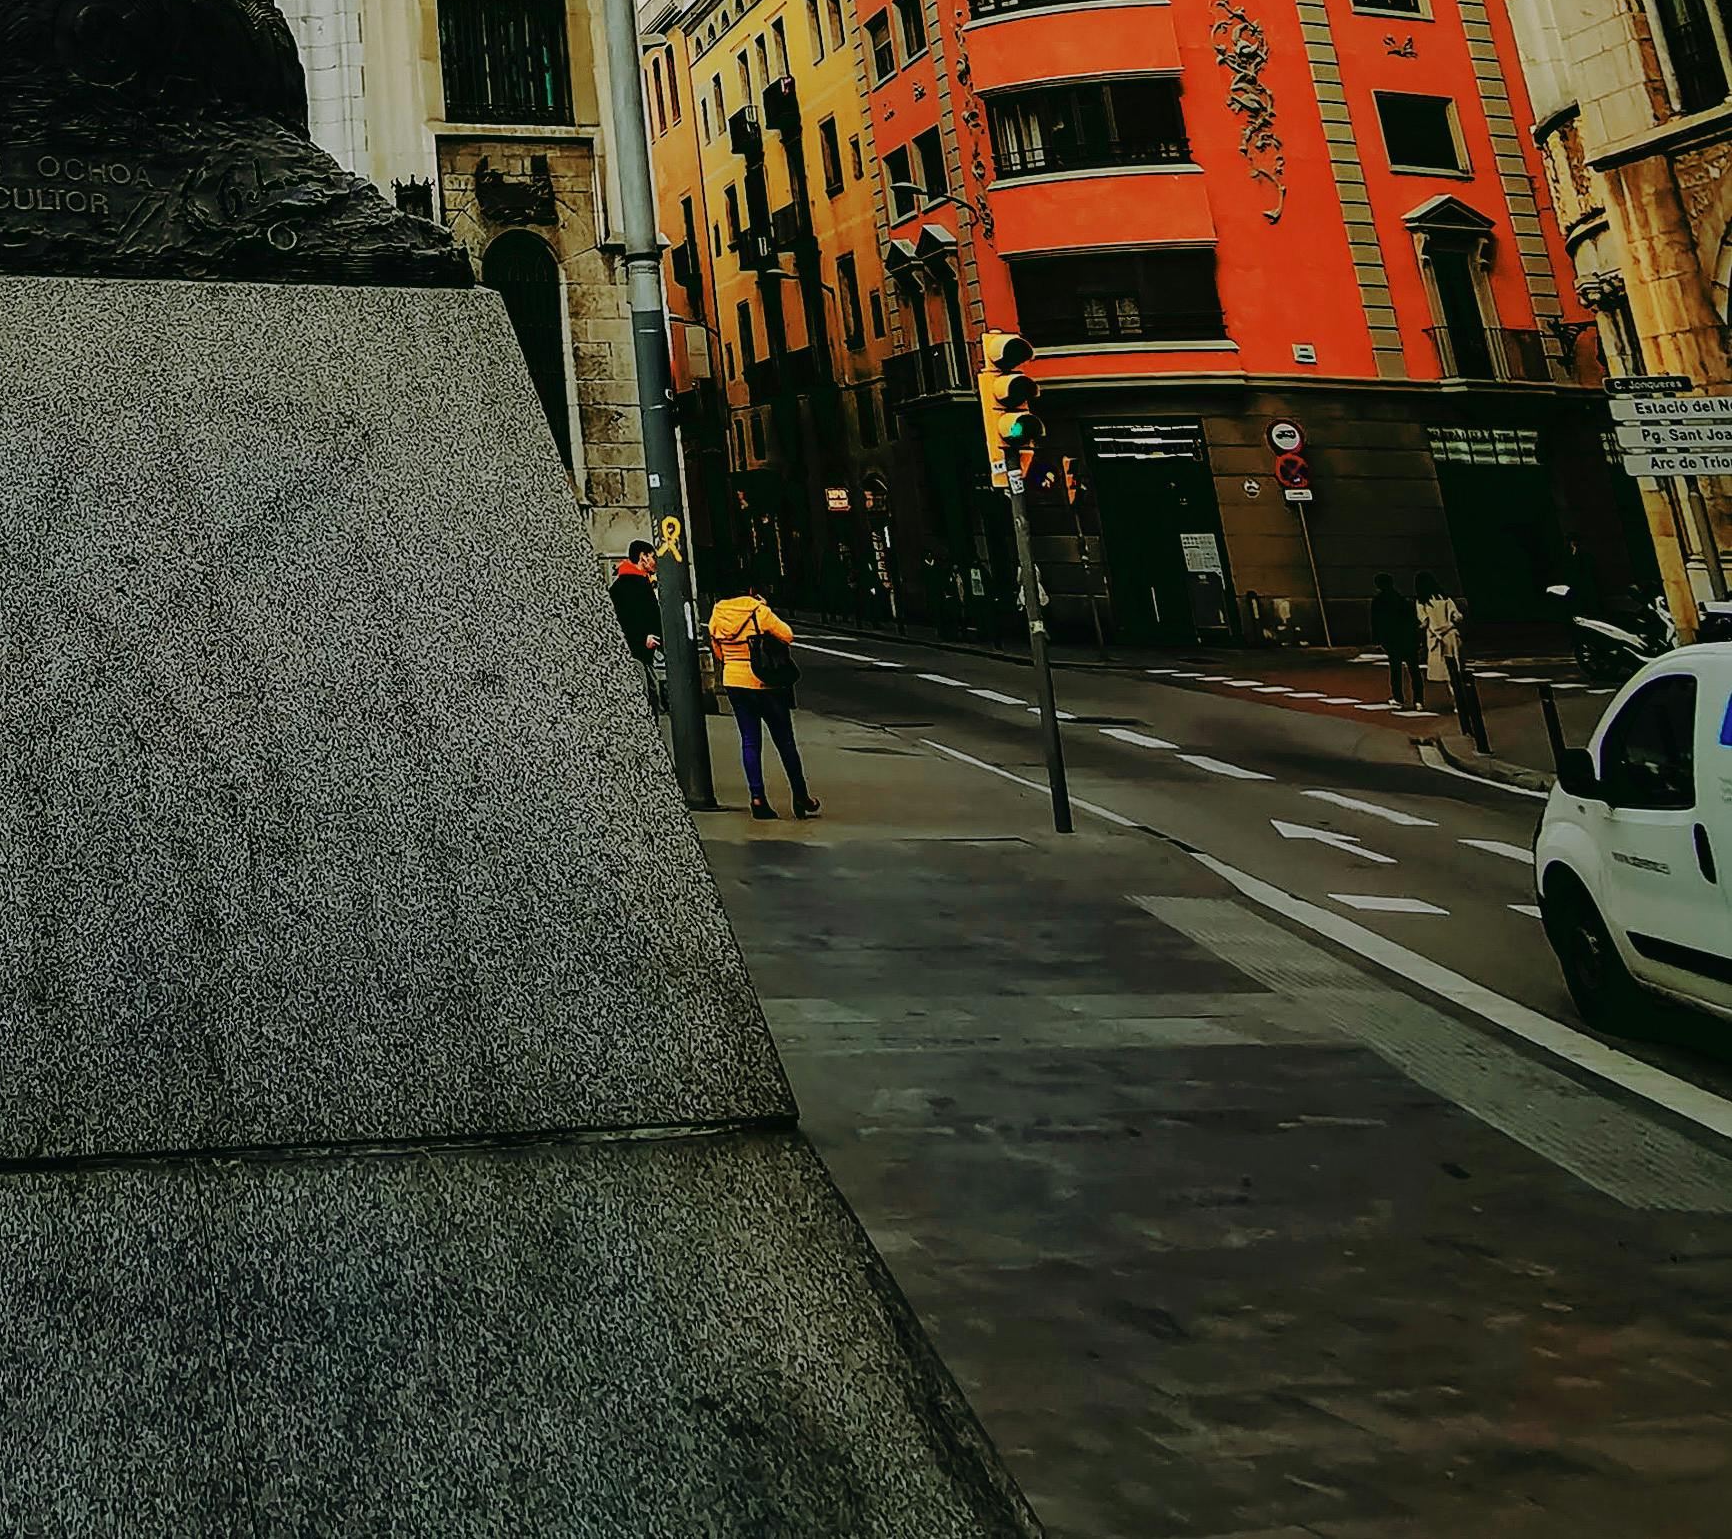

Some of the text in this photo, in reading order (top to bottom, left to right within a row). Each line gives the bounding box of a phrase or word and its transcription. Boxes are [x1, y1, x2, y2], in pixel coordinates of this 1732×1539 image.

[36, 155, 156, 188] OCHOA
[1635, 401, 1688, 414] Estació
[1692, 399, 1715, 413] del
[1642, 428, 1666, 444] Pg.
[1669, 428, 1703, 441] Sant
[1651, 455, 1732, 470] Arc de Trio
